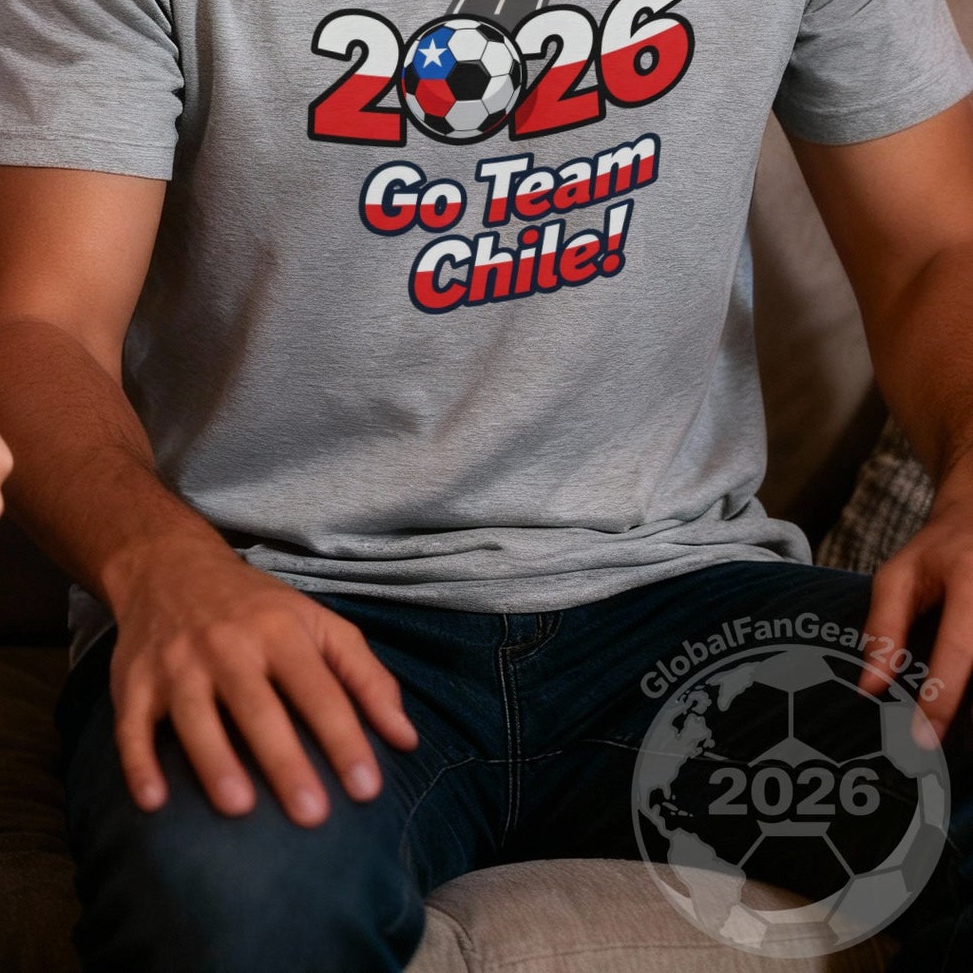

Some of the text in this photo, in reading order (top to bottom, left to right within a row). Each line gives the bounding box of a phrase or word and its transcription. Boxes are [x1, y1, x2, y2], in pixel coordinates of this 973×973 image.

[360, 132, 661, 236] Go Team
[408, 199, 634, 314] Chile!
